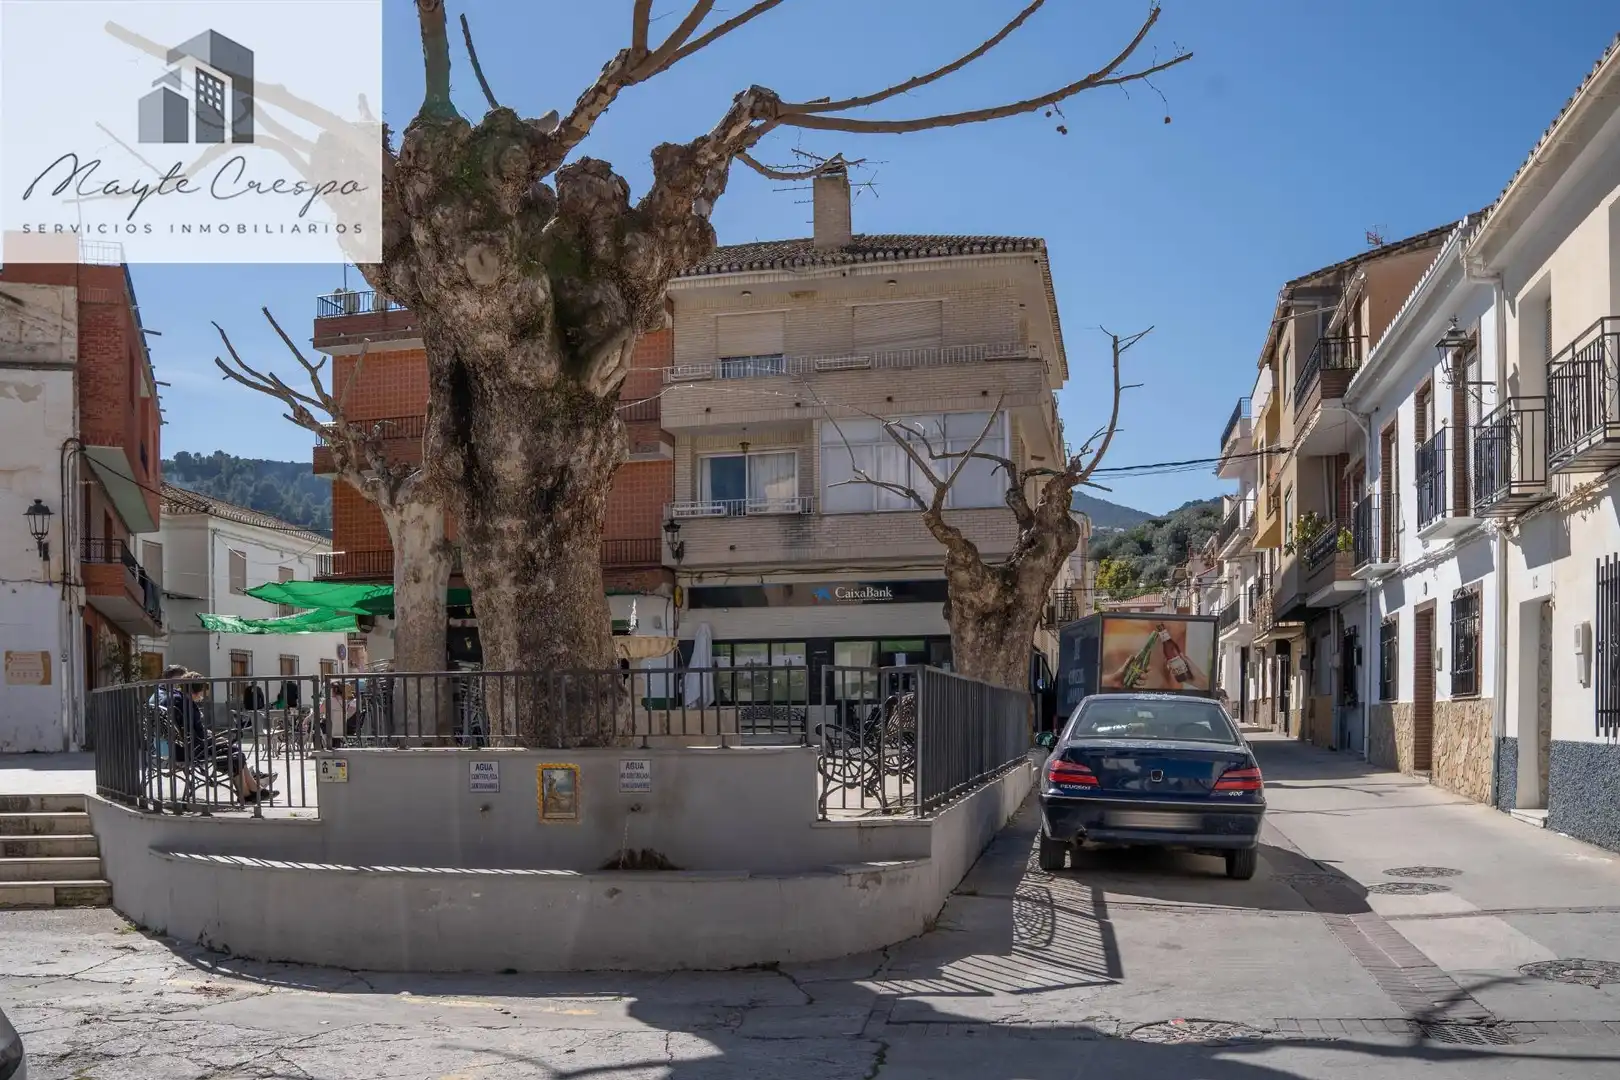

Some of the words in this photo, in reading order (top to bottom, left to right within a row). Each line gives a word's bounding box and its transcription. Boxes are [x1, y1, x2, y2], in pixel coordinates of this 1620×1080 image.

[835, 586, 893, 598] CaixaBank
[475, 763, 494, 771] AGUA
[625, 761, 645, 770] AGUA
